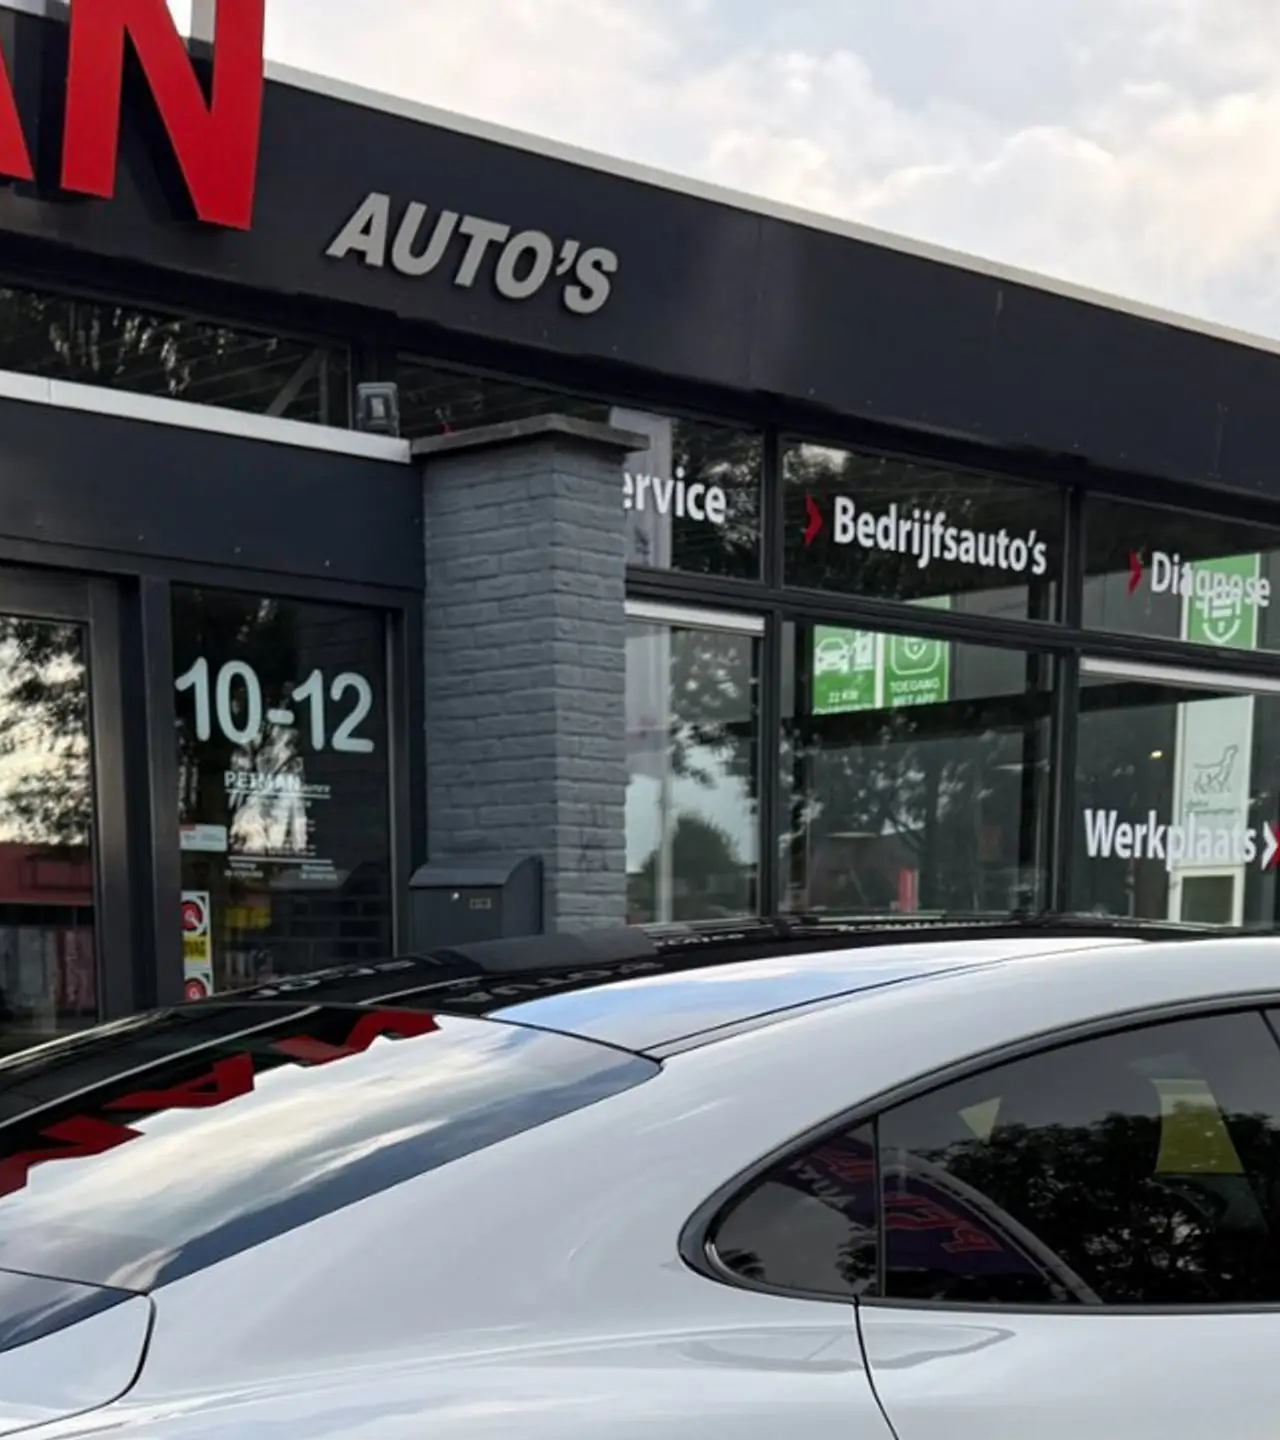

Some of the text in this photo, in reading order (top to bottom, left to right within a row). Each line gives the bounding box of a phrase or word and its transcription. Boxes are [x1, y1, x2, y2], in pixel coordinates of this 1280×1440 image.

[325, 191, 618, 314] AUTO'S
[833, 496, 1047, 575] Bedrijfsauto's
[1151, 551, 1270, 608] Diagnose
[175, 656, 375, 753] 10-12
[1083, 808, 1257, 872] Werkplaats
